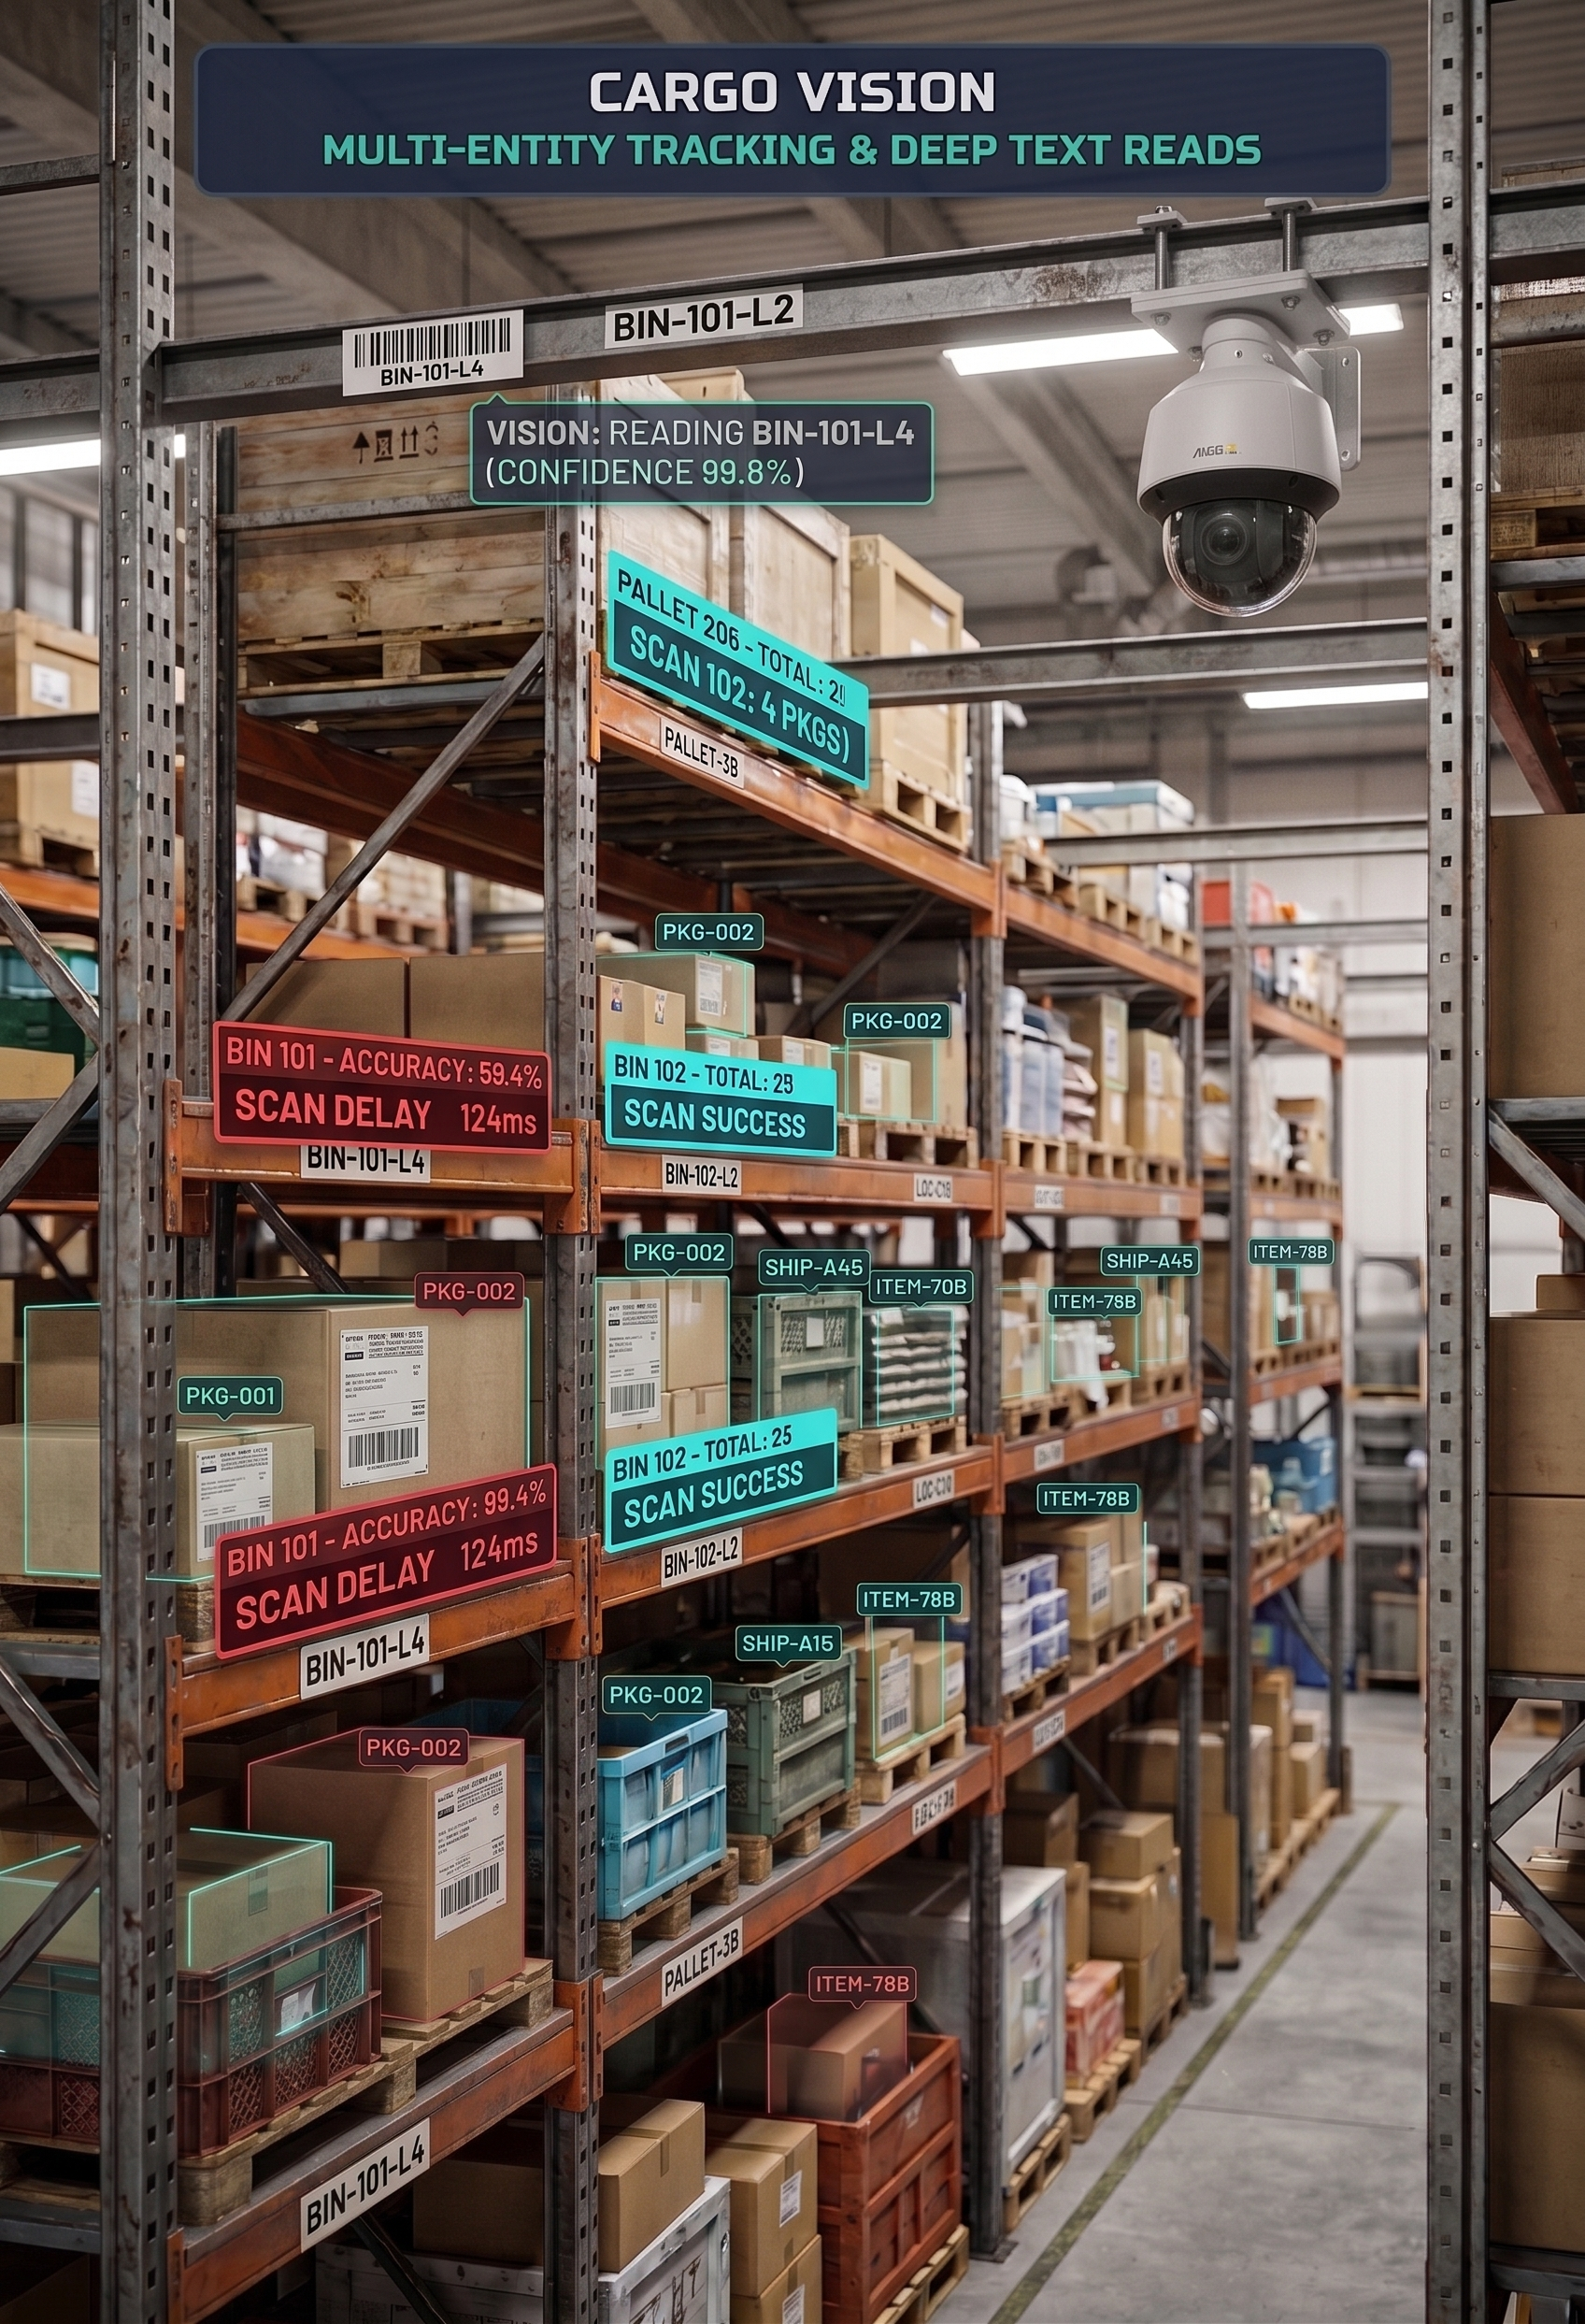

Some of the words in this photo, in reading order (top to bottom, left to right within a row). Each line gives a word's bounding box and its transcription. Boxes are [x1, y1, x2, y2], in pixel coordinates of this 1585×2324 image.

[614, 294, 794, 344] BIN-101-L2
[380, 359, 484, 387] BIN-101-L4
[664, 725, 738, 779] PALLET-3B
[307, 1146, 425, 1174] BIN-101-L4
[665, 1162, 738, 1193] BIN-102-L2
[664, 1535, 738, 1579] BIN-102-L2
[307, 1625, 425, 1687] BIN-101-L4
[664, 1928, 739, 1997] PALLET-3B
[307, 2134, 425, 2236] BIN-101-L4
